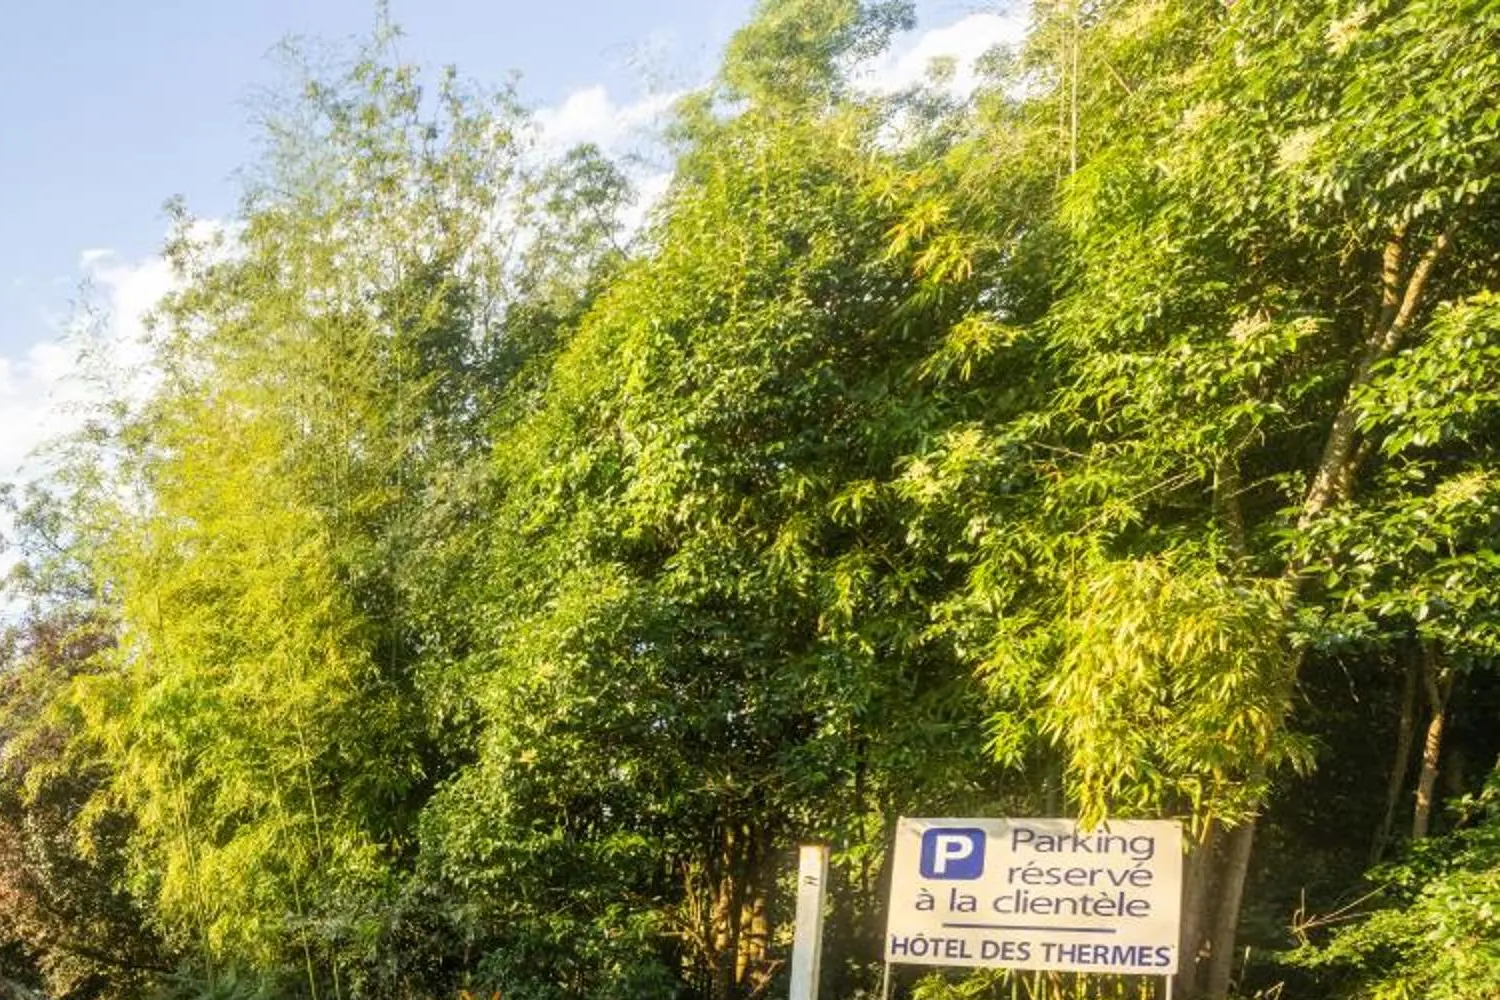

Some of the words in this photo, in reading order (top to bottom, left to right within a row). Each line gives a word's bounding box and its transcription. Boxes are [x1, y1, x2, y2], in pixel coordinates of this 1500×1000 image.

[933, 834, 974, 875] P
[1011, 827, 1156, 861] Parking
[1007, 860, 1154, 888] réservé
[915, 888, 936, 912] à
[950, 888, 977, 913] la
[992, 889, 1151, 918] clientèle
[890, 933, 973, 960] HÔTEL
[980, 939, 1031, 962] DES
[1041, 942, 1171, 968] THERMES
